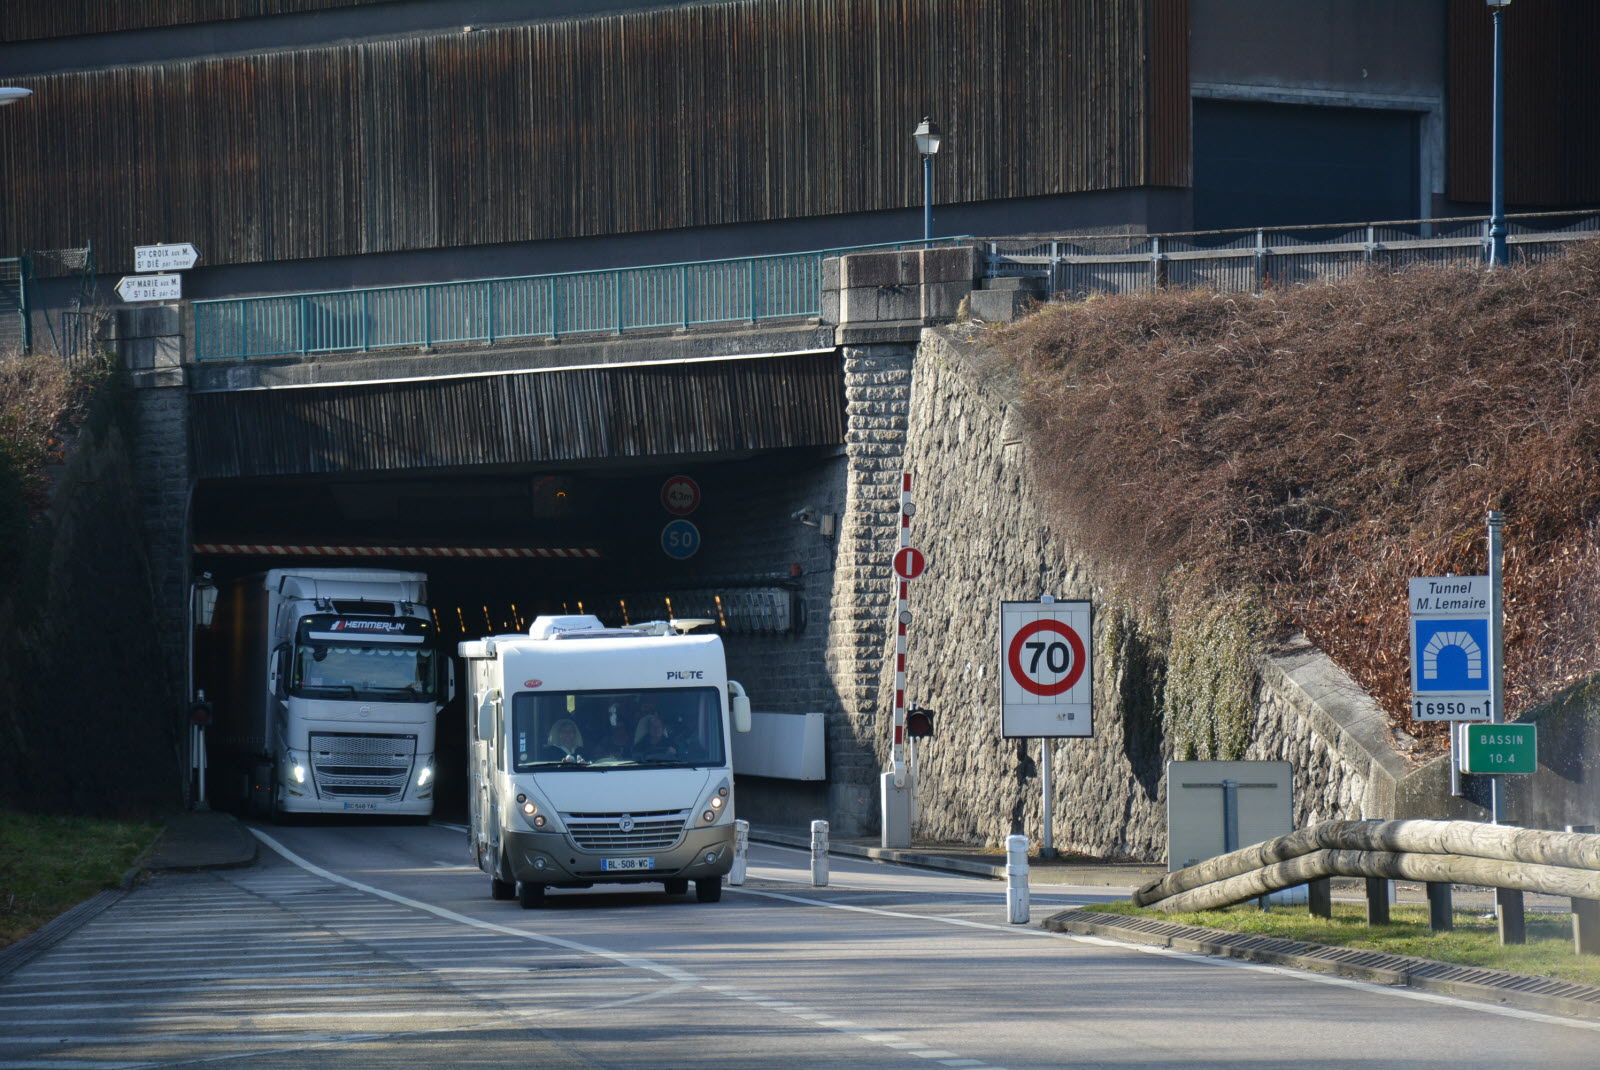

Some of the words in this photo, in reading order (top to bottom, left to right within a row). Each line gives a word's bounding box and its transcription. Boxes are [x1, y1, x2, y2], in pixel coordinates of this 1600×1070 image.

[148, 249, 169, 258] CROIX
[182, 247, 190, 256] M.
[147, 259, 159, 268] DIÉ
[137, 279, 158, 288] MARIE
[171, 278, 178, 286] M.
[143, 288, 156, 298] DIÉ
[670, 531, 692, 547] 50
[1429, 581, 1472, 594] Tunnel
[1416, 597, 1432, 610] M.
[1435, 596, 1486, 610] Lemaire
[344, 620, 406, 632] HEMMERLIN
[1025, 641, 1070, 674] 70
[1426, 702, 1466, 715] 6950
[1470, 706, 1481, 715] m
[1480, 735, 1524, 745] BASSIN
[1489, 753, 1515, 764] 10.4
[623, 821, 631, 829] P
